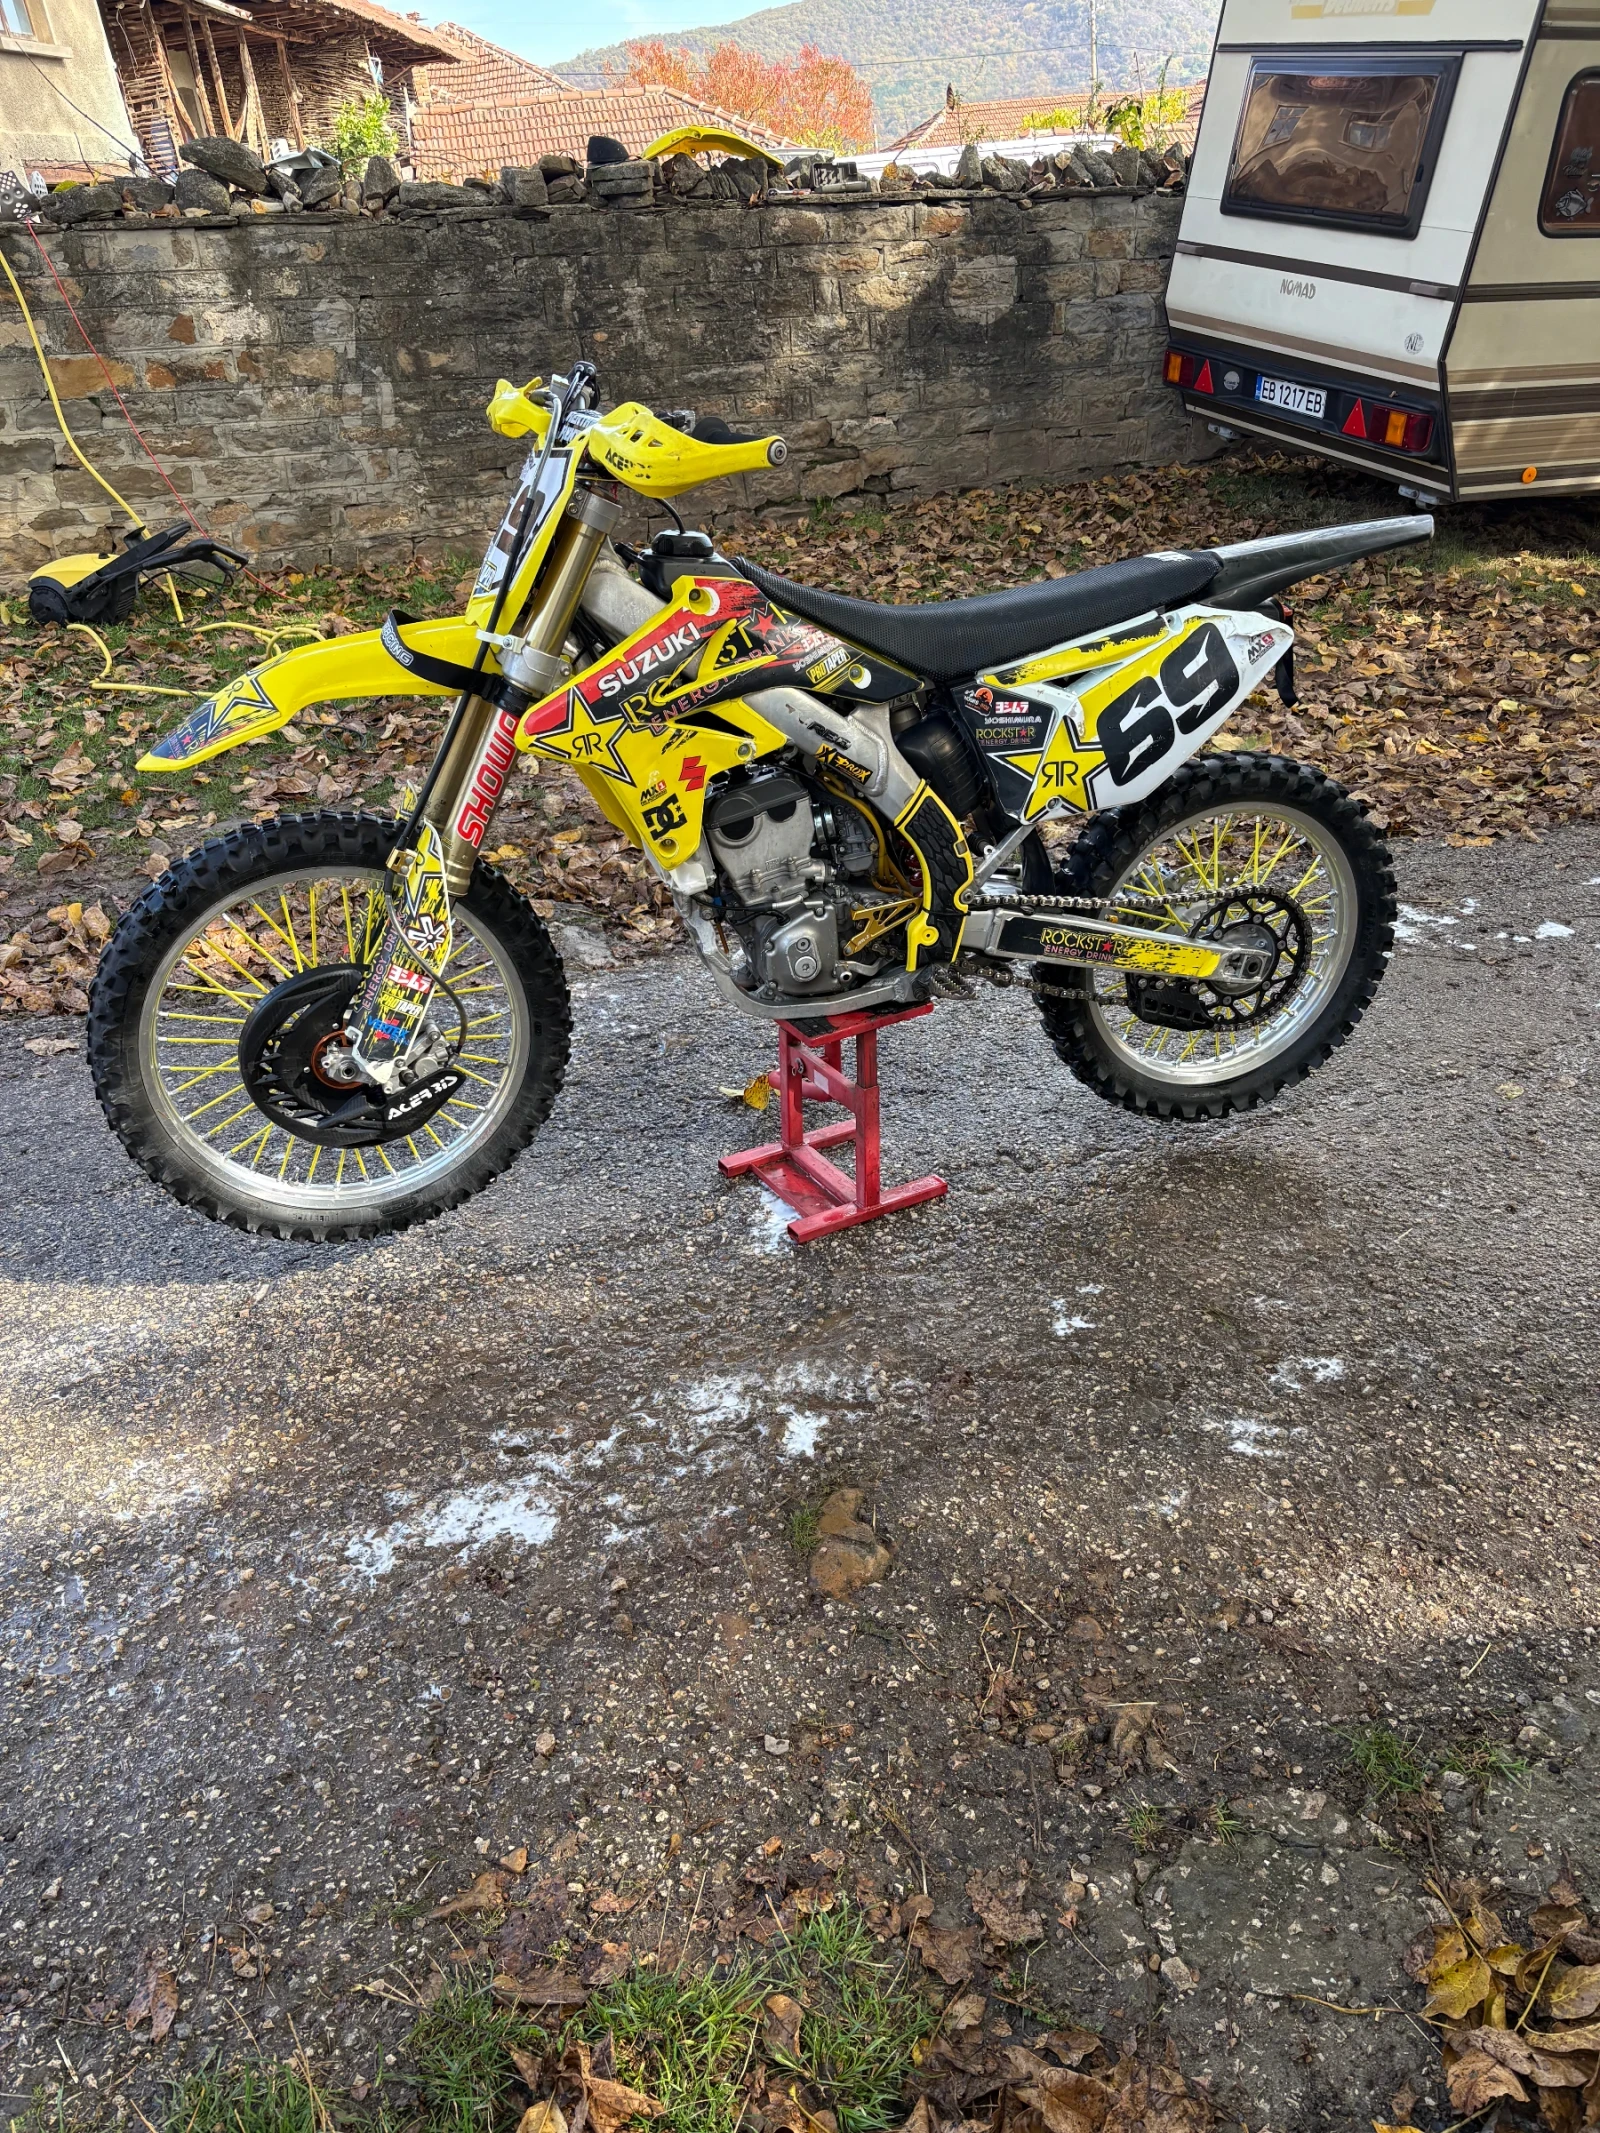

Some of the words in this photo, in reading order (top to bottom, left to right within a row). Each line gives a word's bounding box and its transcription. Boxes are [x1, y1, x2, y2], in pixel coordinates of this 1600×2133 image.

[1279, 278, 1317, 300] NOMAD
[1261, 380, 1276, 401] EB
[1279, 385, 1305, 408] 1217
[1305, 391, 1323, 414] EB
[597, 621, 701, 698] SUZUKI
[984, 715, 1042, 725] YOSHIMURA
[1096, 622, 1240, 787] 69
[1044, 944, 1083, 957] ENERGY
[1085, 950, 1114, 962] DRINK
[362, 956, 387, 1009] ENERGY
